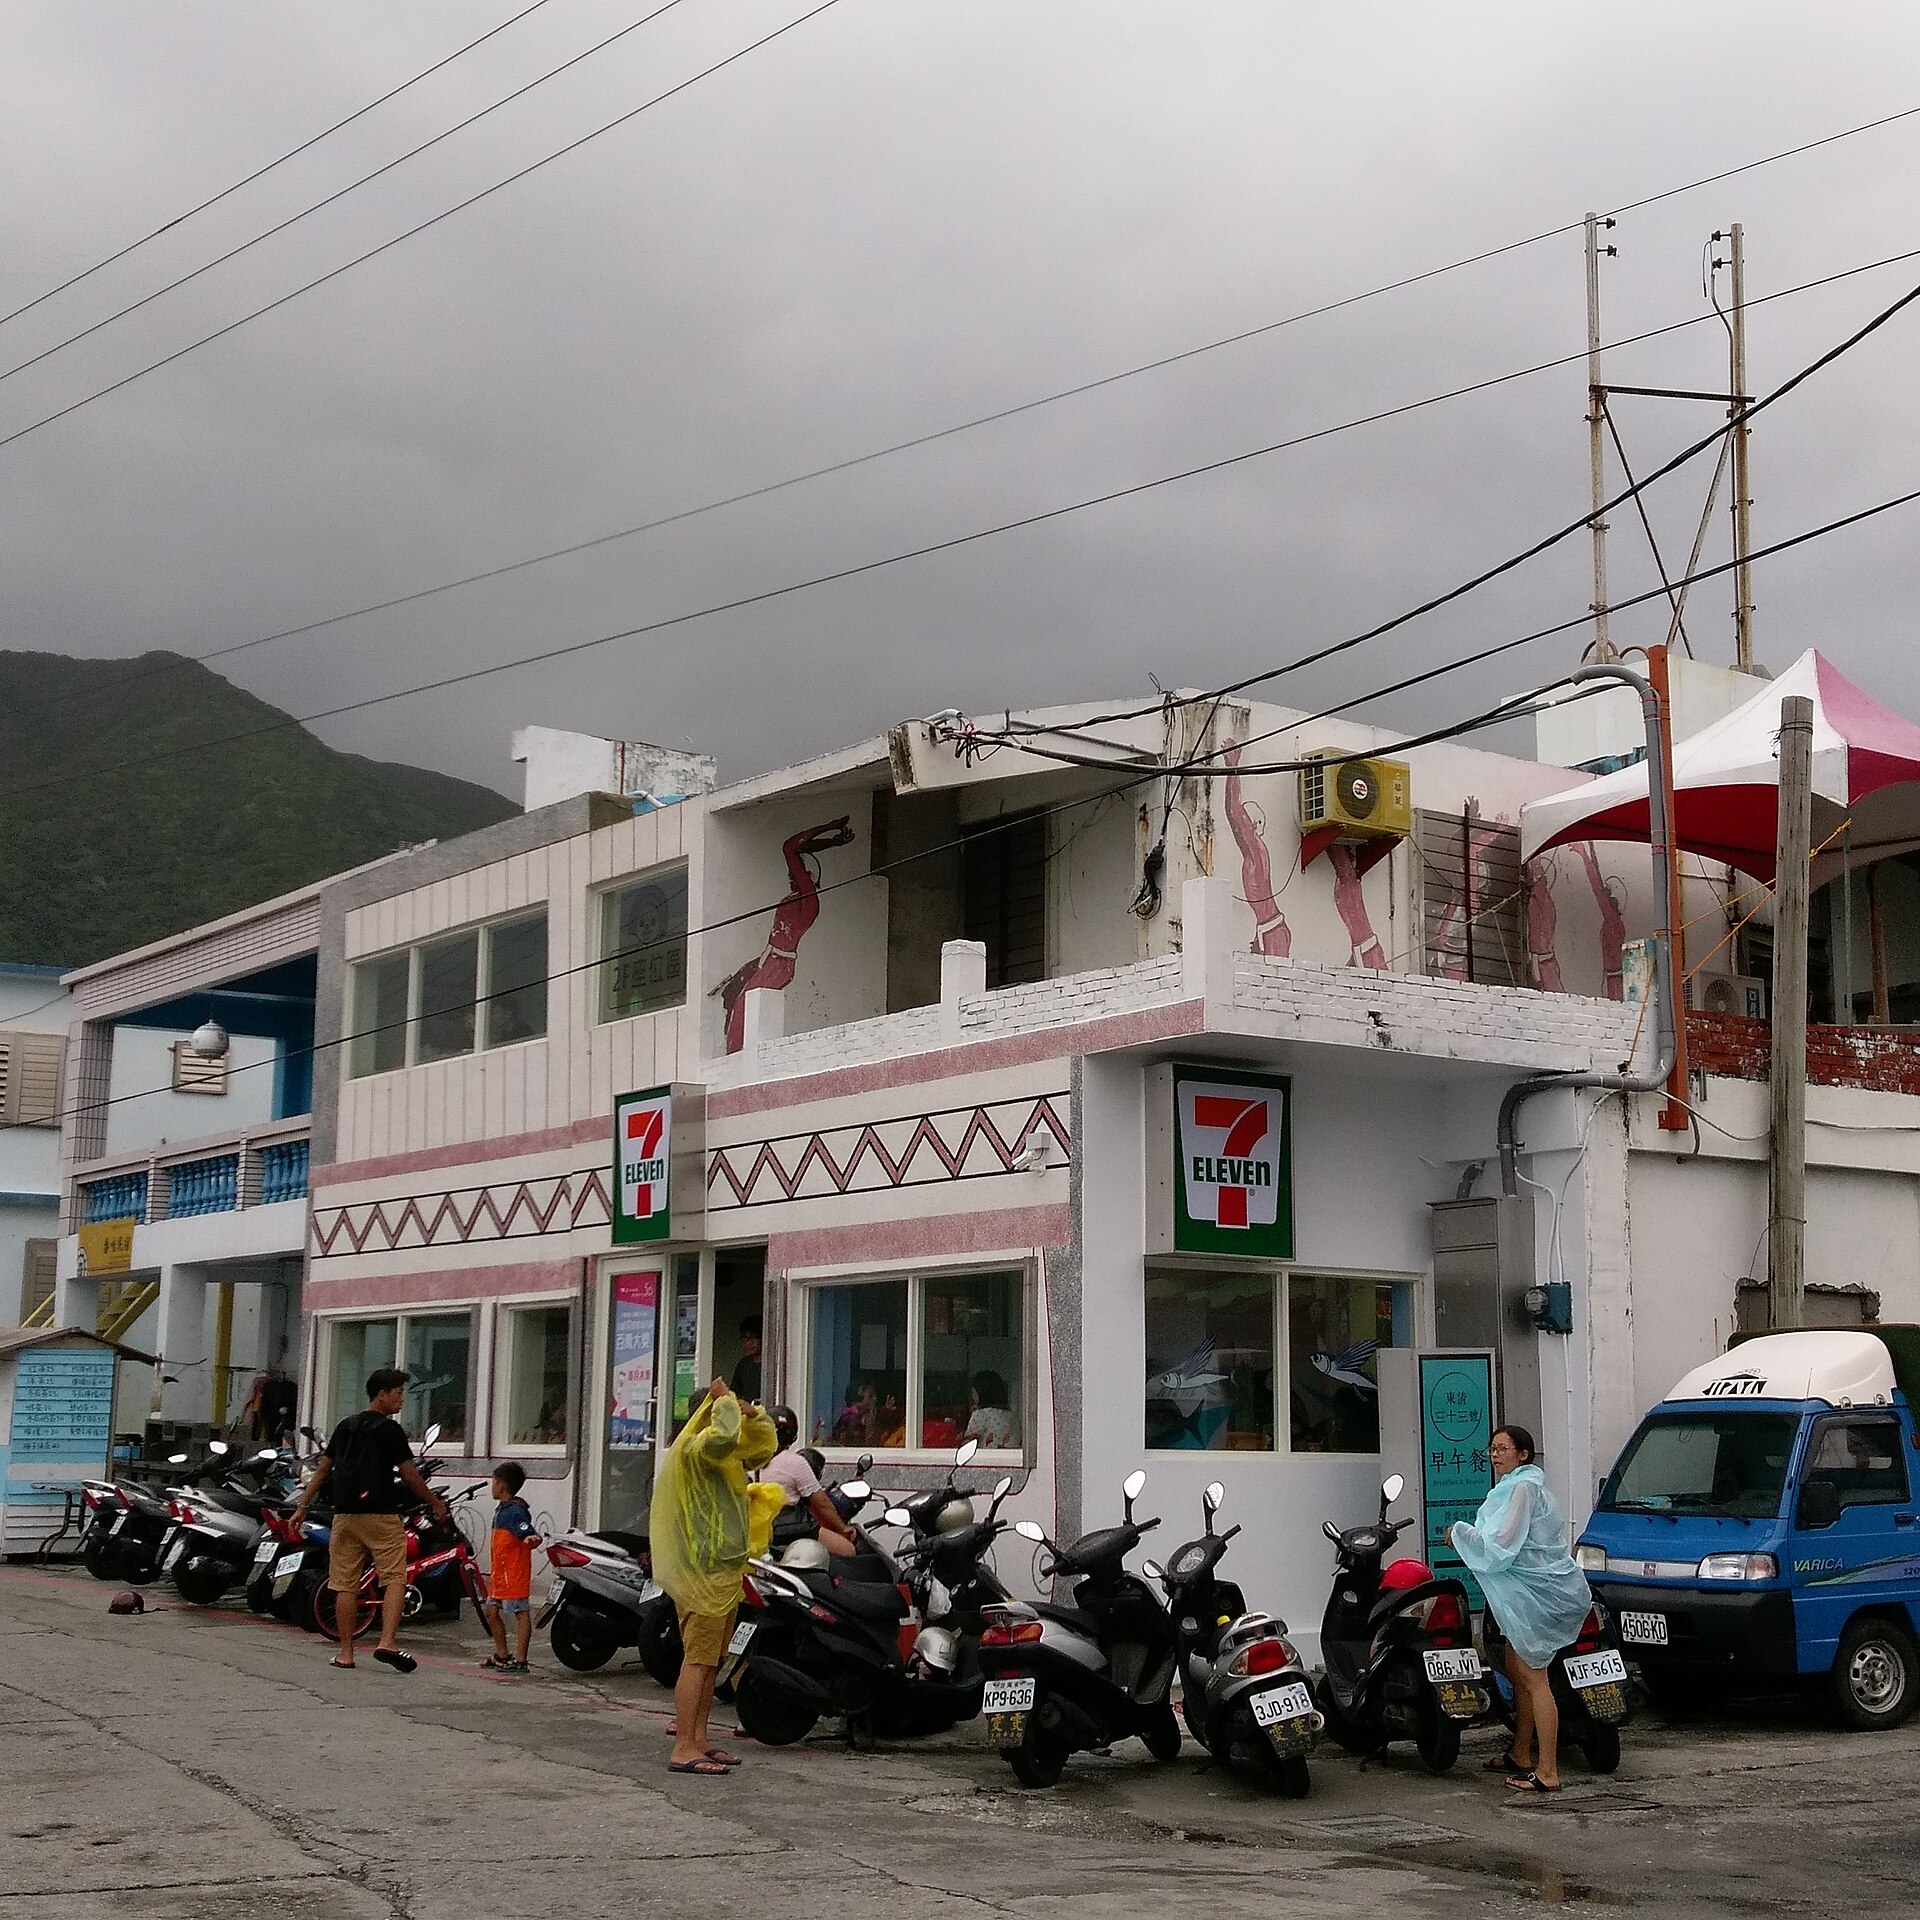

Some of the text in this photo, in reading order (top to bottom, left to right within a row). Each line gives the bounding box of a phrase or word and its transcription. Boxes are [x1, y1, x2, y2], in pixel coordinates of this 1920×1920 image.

[628, 1108, 663, 1216] 7
[1195, 1096, 1268, 1227] 7
[1446, 1391, 1467, 1405] 東清
[1435, 1409, 1480, 1423] 三十三號
[1430, 1448, 1488, 1474] 早午餐
[1794, 1557, 1844, 1572] VARICA
[984, 1689, 1032, 1707] KP9-636
[1255, 1693, 1310, 1720] 3JD-918
